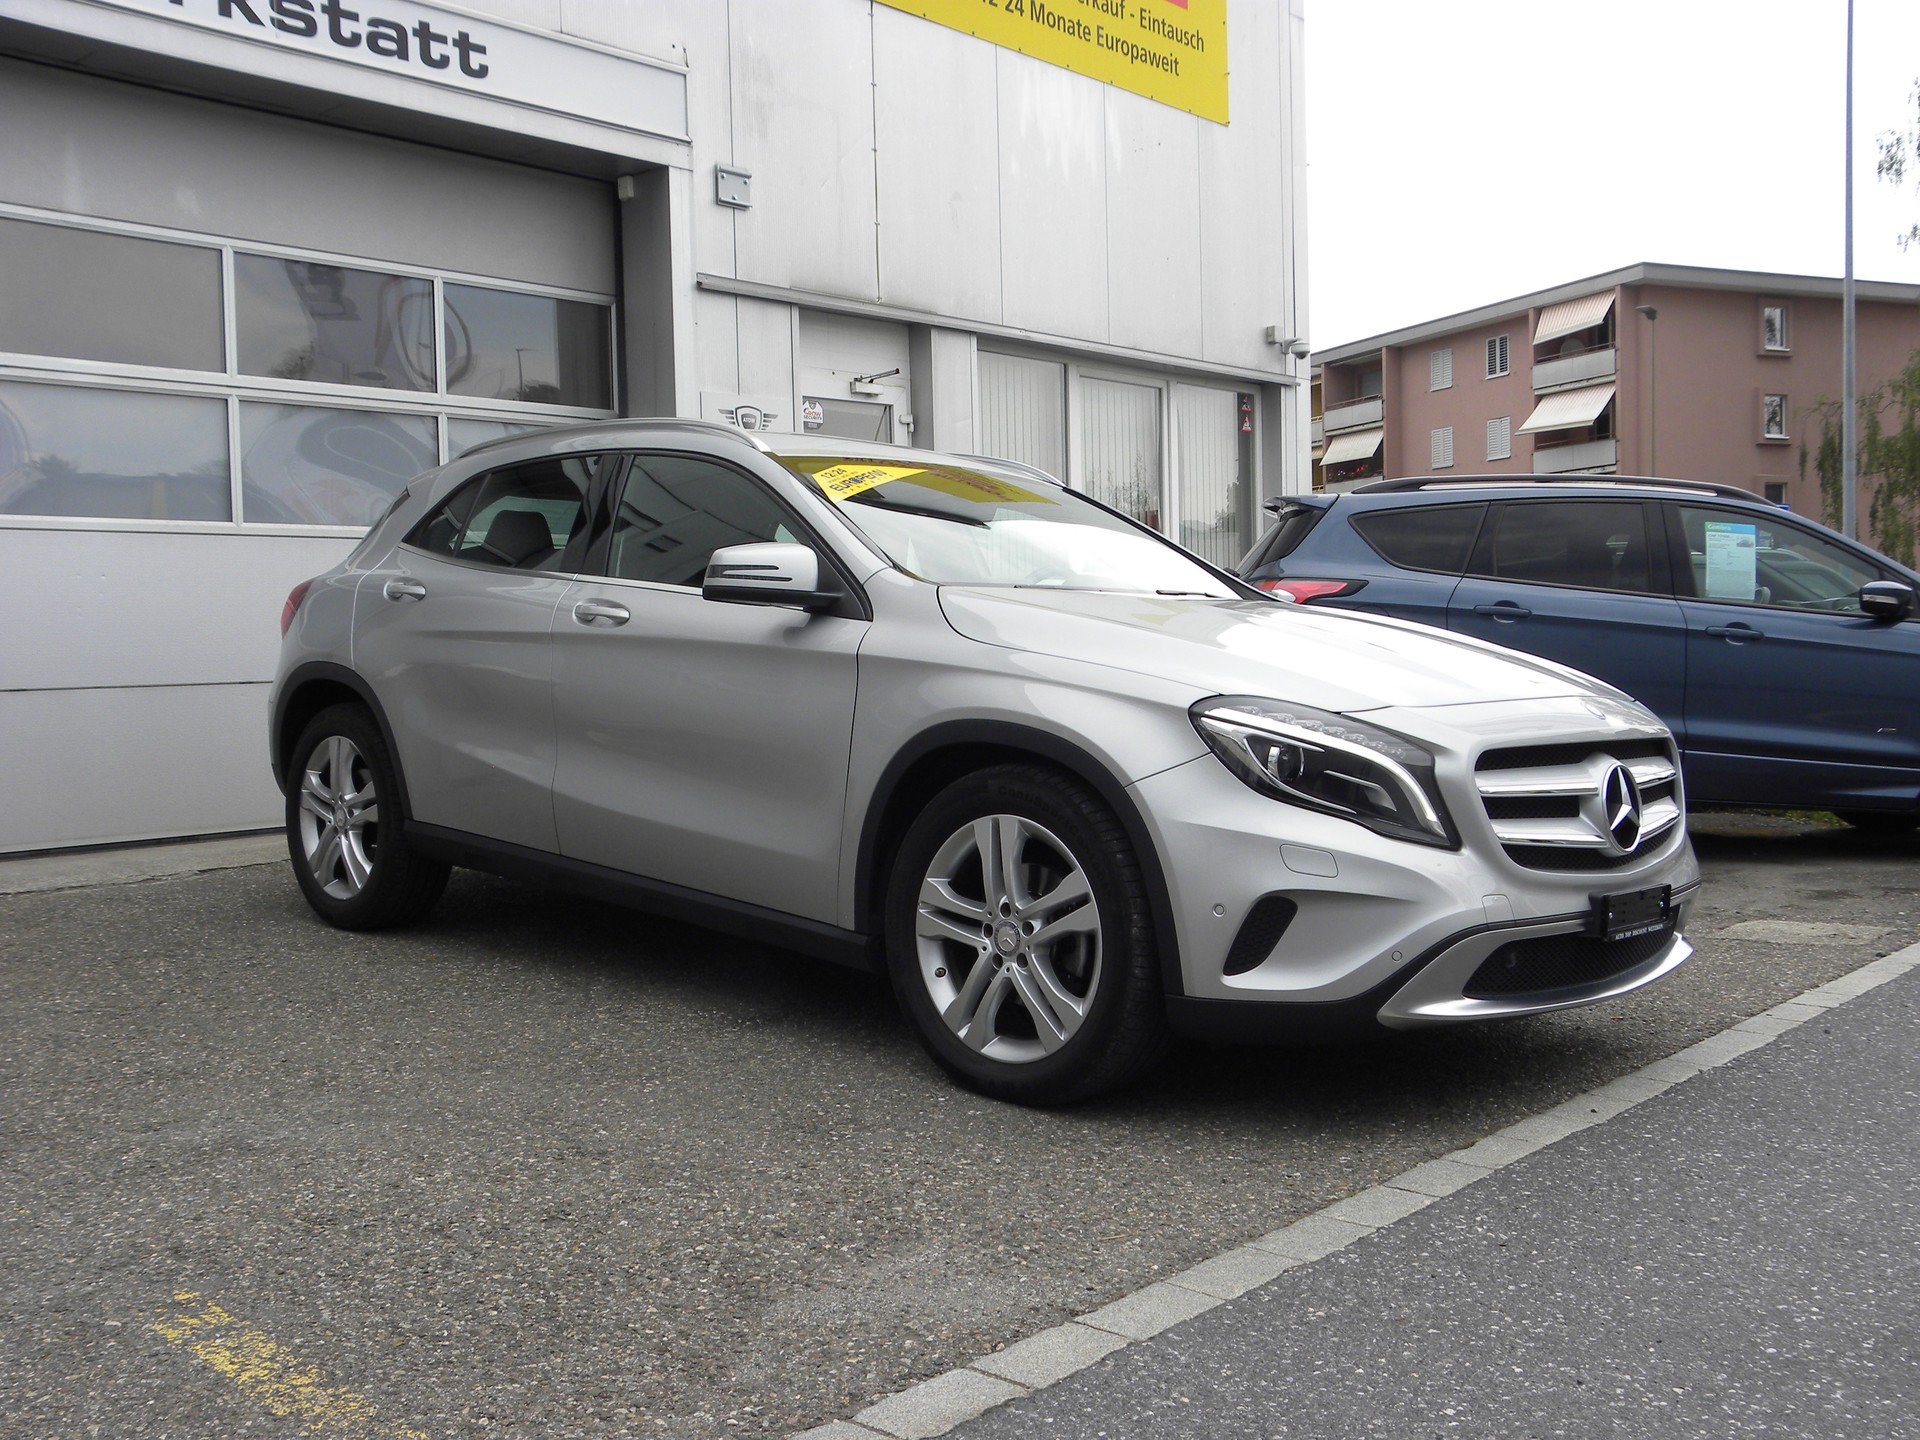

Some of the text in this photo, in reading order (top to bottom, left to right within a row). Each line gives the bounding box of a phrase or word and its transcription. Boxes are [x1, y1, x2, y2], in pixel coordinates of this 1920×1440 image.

[169, 0, 489, 79] statt
[1030, 0, 1091, 42] Monate
[1096, 25, 1180, 77] Europaweit
[1140, 8, 1204, 52] Eintausch
